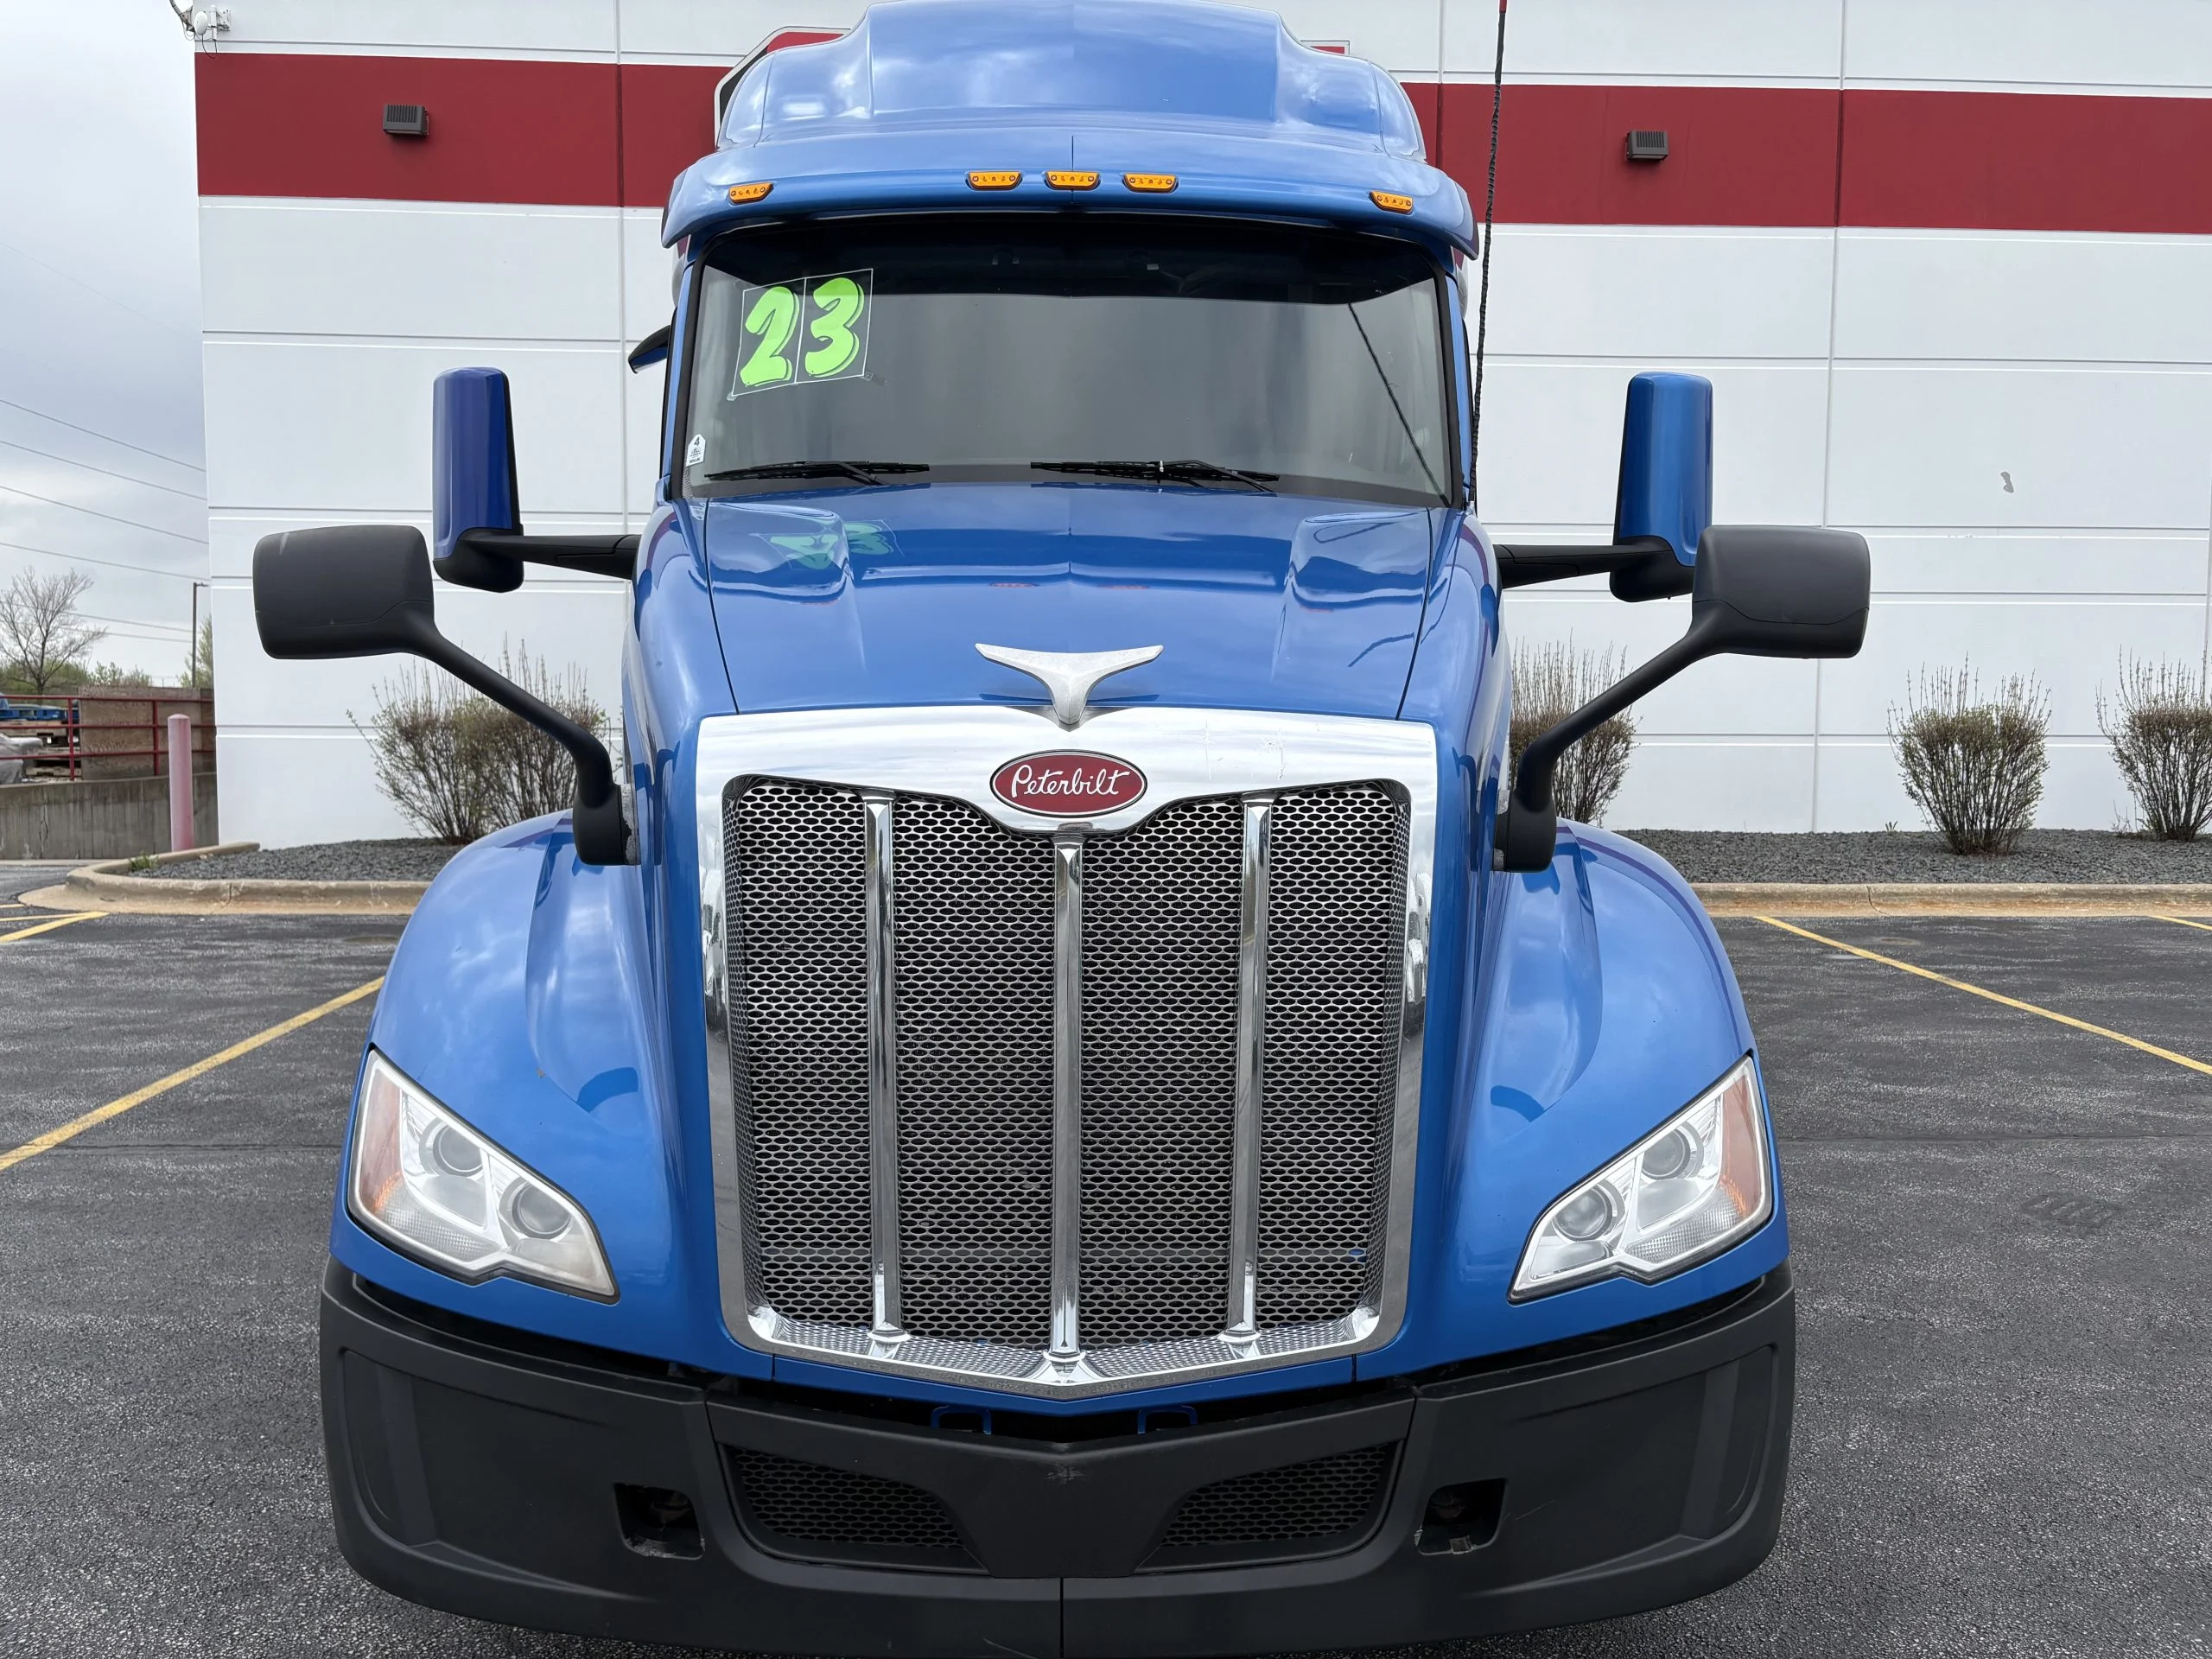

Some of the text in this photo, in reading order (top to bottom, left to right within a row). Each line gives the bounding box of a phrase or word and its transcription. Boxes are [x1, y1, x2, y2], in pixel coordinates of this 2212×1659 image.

[740, 277, 864, 386] 23
[694, 436, 701, 447] 4
[1011, 765, 1130, 798] Peterbilt
